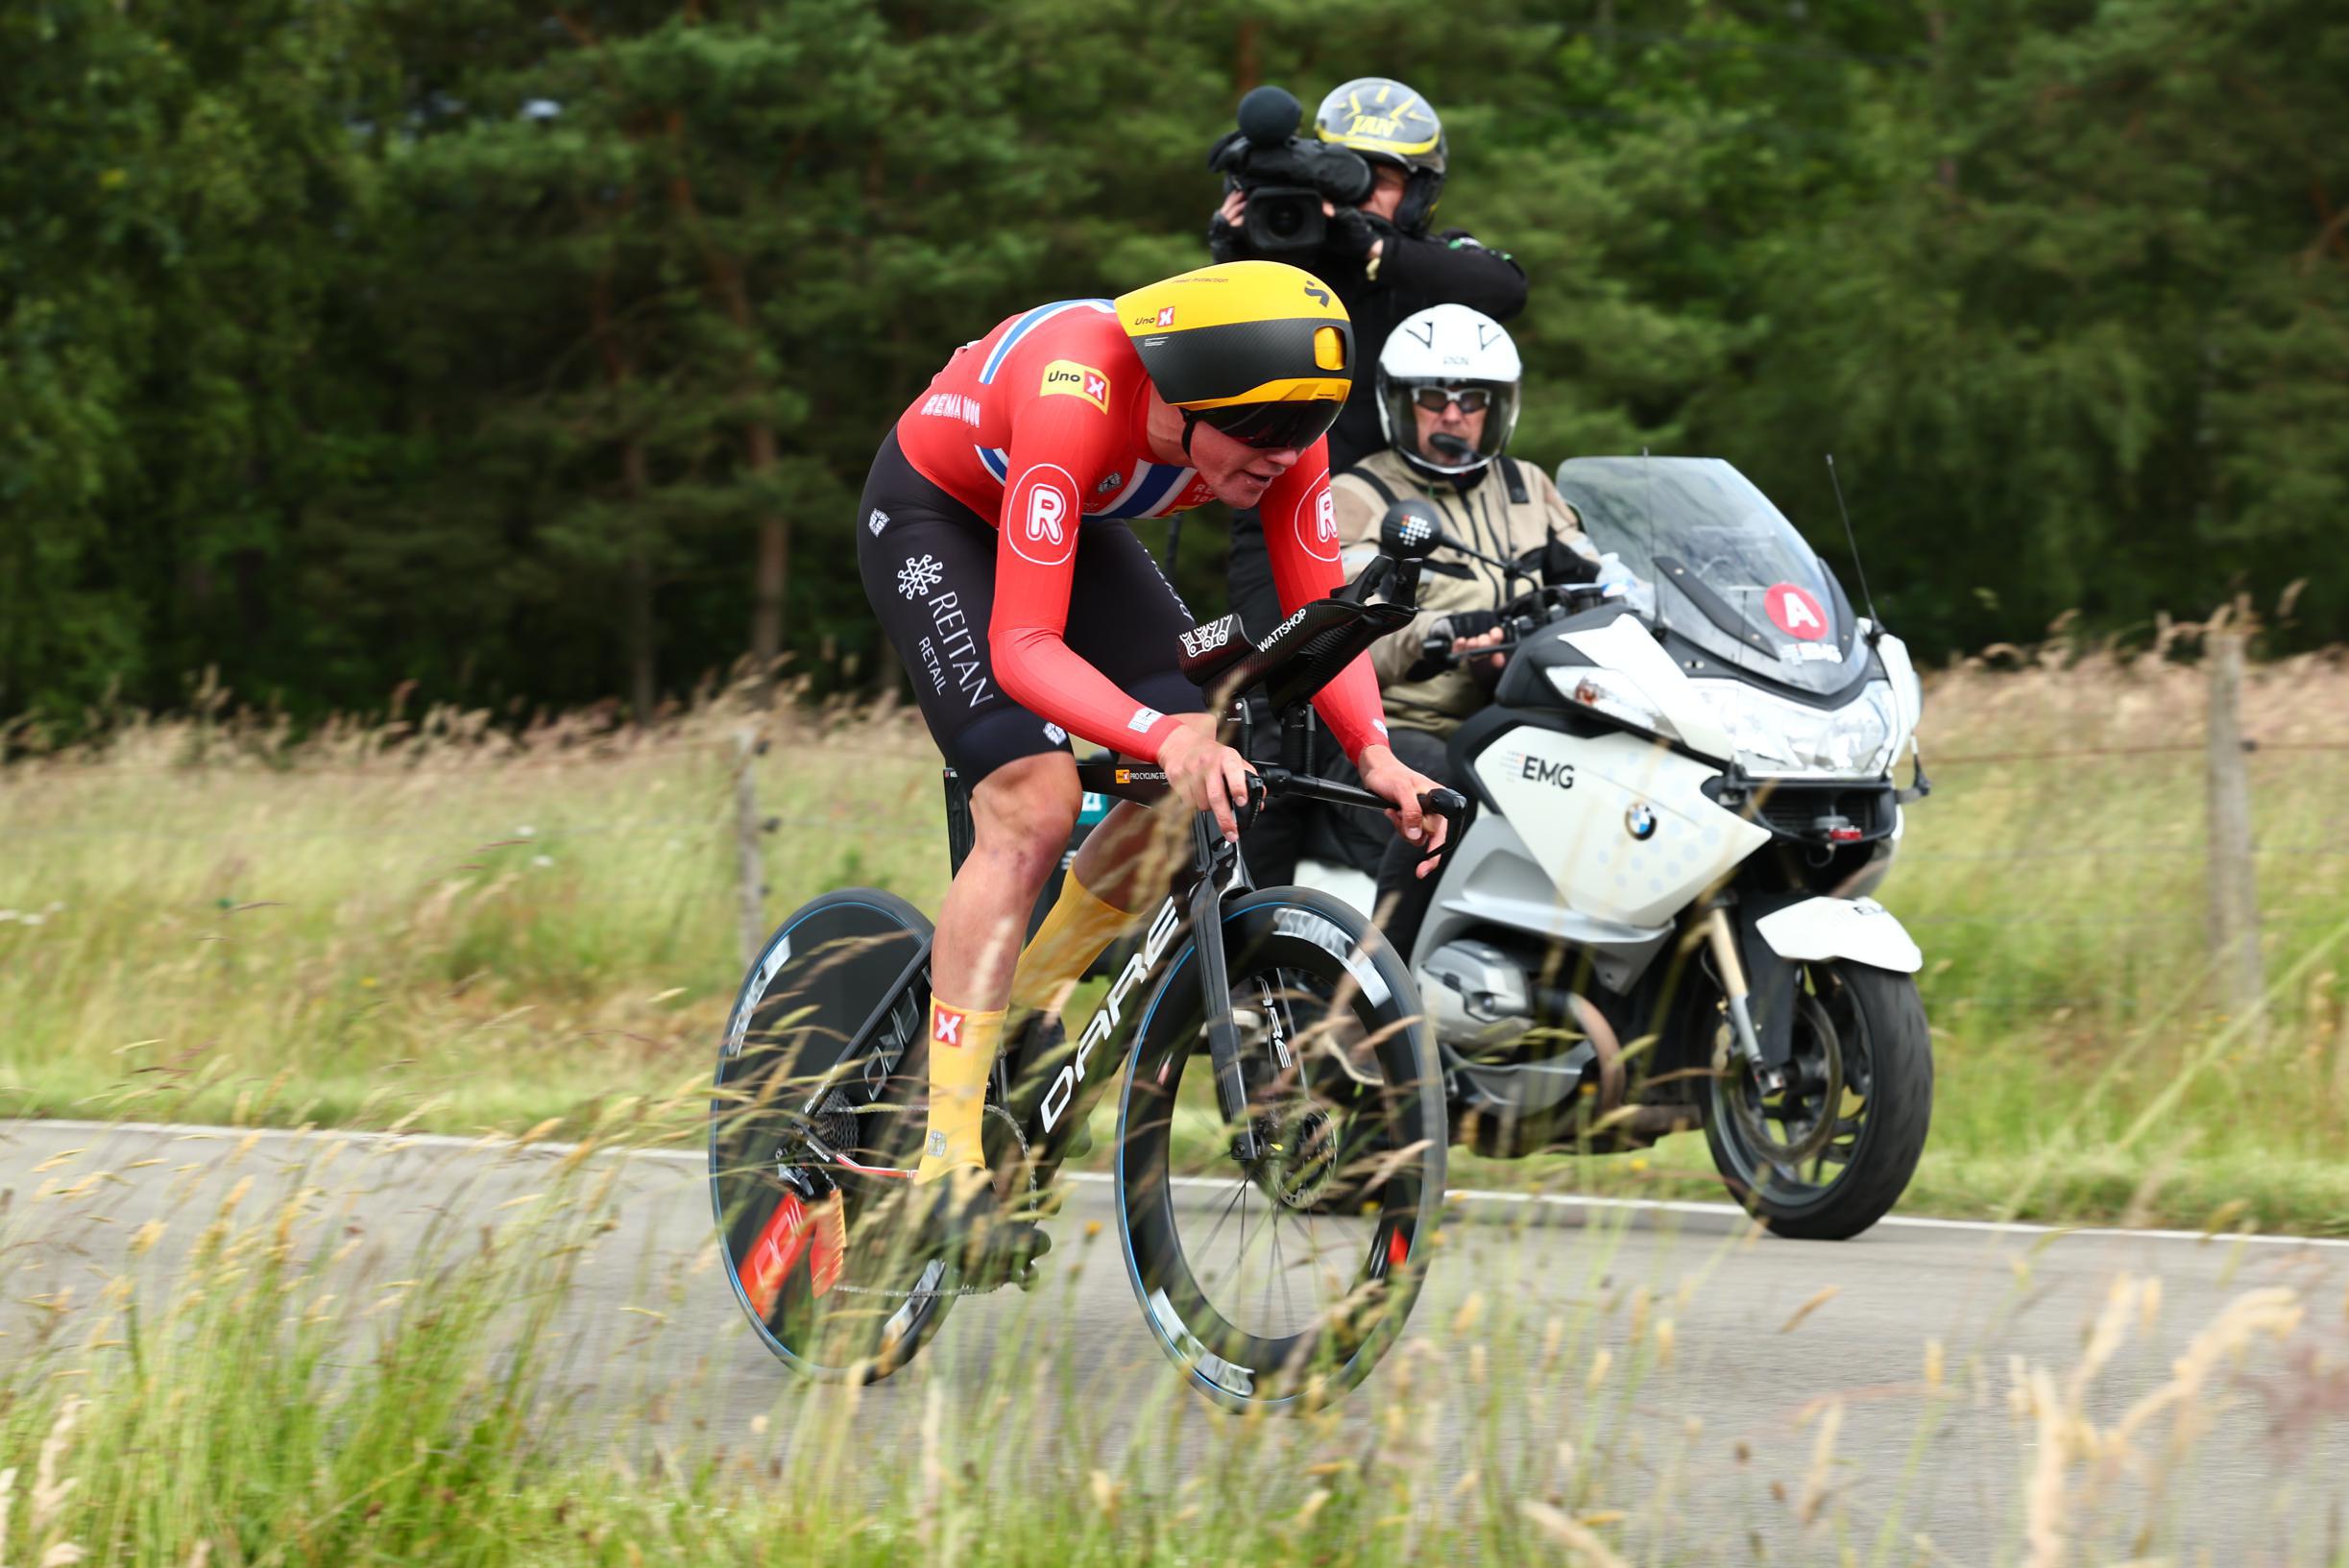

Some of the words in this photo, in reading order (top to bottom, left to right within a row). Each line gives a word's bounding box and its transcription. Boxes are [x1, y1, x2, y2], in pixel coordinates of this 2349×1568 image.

[1134, 316, 1155, 326] Uno
[1157, 306, 1174, 326] X
[1048, 371, 1081, 383] Uno
[1087, 376, 1105, 401] X
[920, 393, 961, 421] REMA
[1026, 483, 1066, 545] R
[1256, 608, 1307, 653] WATTSHOP
[1782, 591, 1822, 629] A
[918, 636, 947, 696] RETAIL
[928, 591, 994, 709] REITAN
[1522, 755, 1575, 789] EMG
[935, 1011, 962, 1046] X
[1040, 895, 1179, 1134] DARE
[1255, 975, 1292, 1069] ARE
